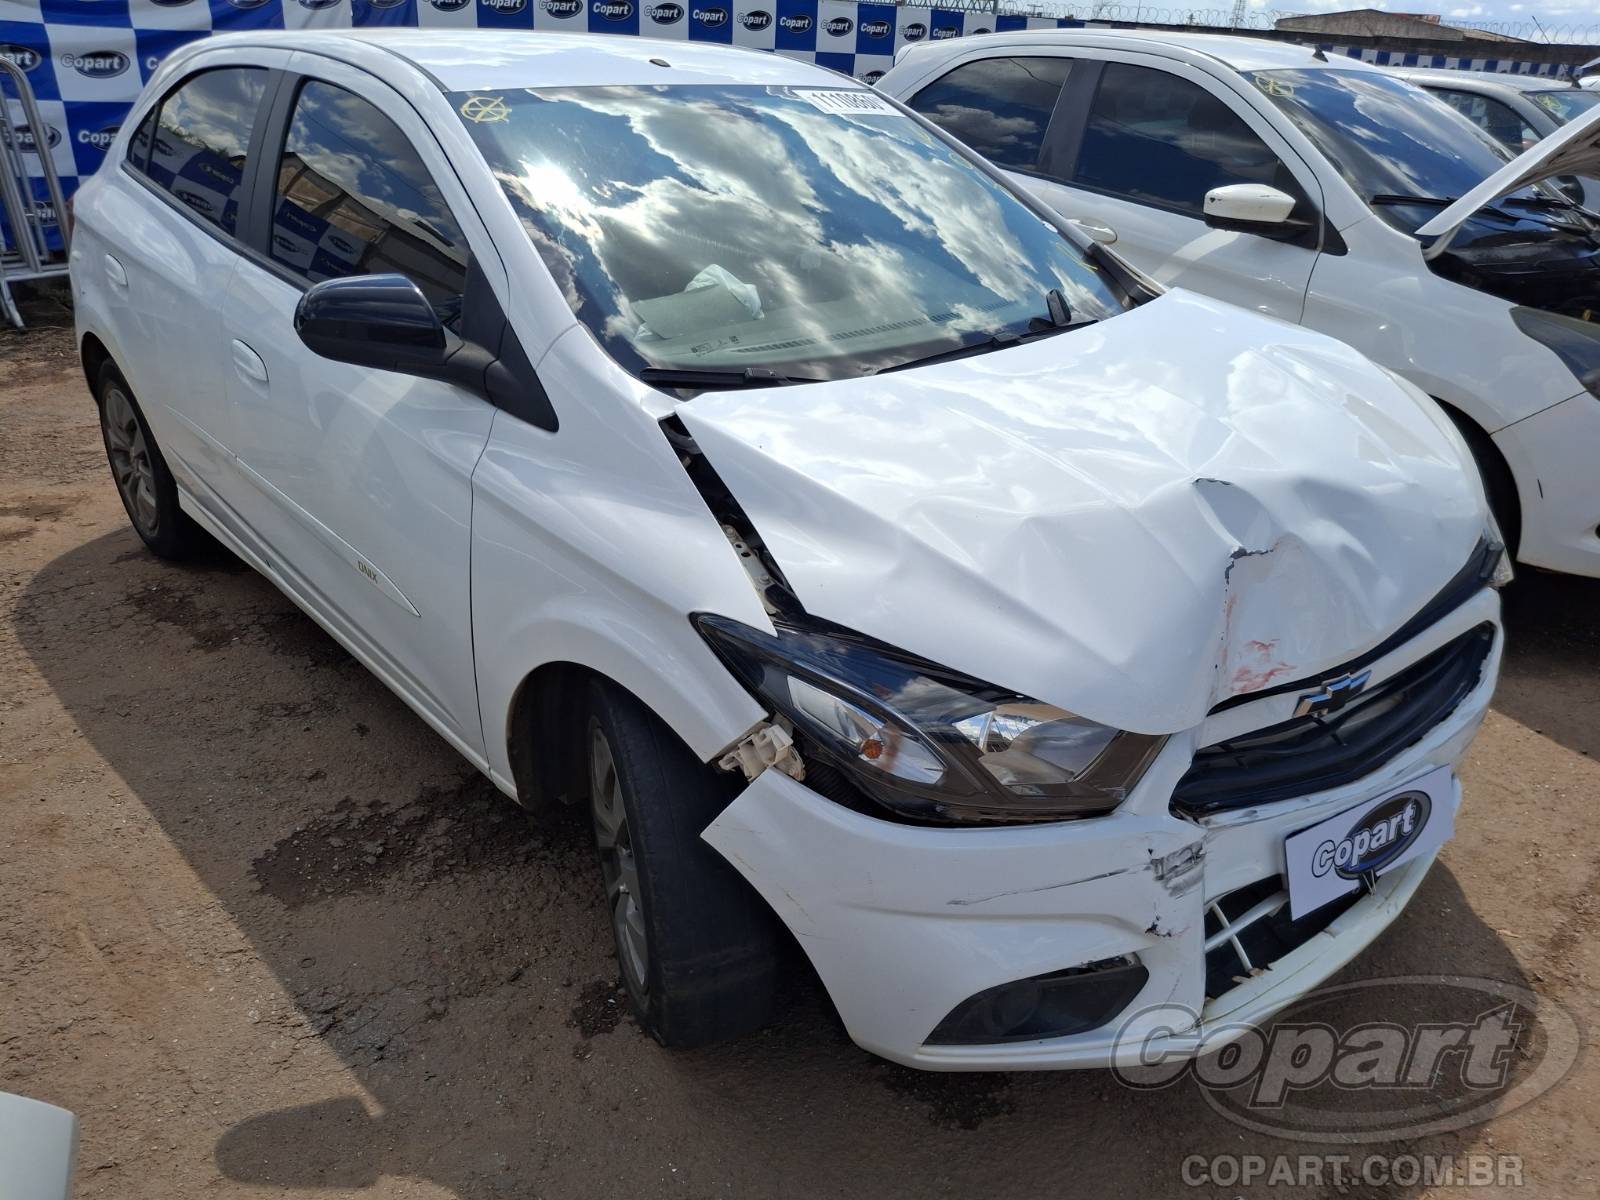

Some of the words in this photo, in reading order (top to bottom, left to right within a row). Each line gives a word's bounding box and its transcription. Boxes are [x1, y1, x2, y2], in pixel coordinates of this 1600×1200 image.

[592, 2, 629, 15] Copart
[644, 5, 679, 20] Copart
[692, 9, 724, 21] Copart
[737, 13, 767, 25] Copart
[780, 17, 809, 28] Copart
[820, 20, 849, 31] Copart
[860, 23, 887, 35] Copart
[899, 25, 923, 37] Copart
[932, 28, 956, 39] Copart
[61, 53, 120, 71] Copart
[357, 560, 378, 584] ONIX
[1311, 798, 1417, 878] Copart
